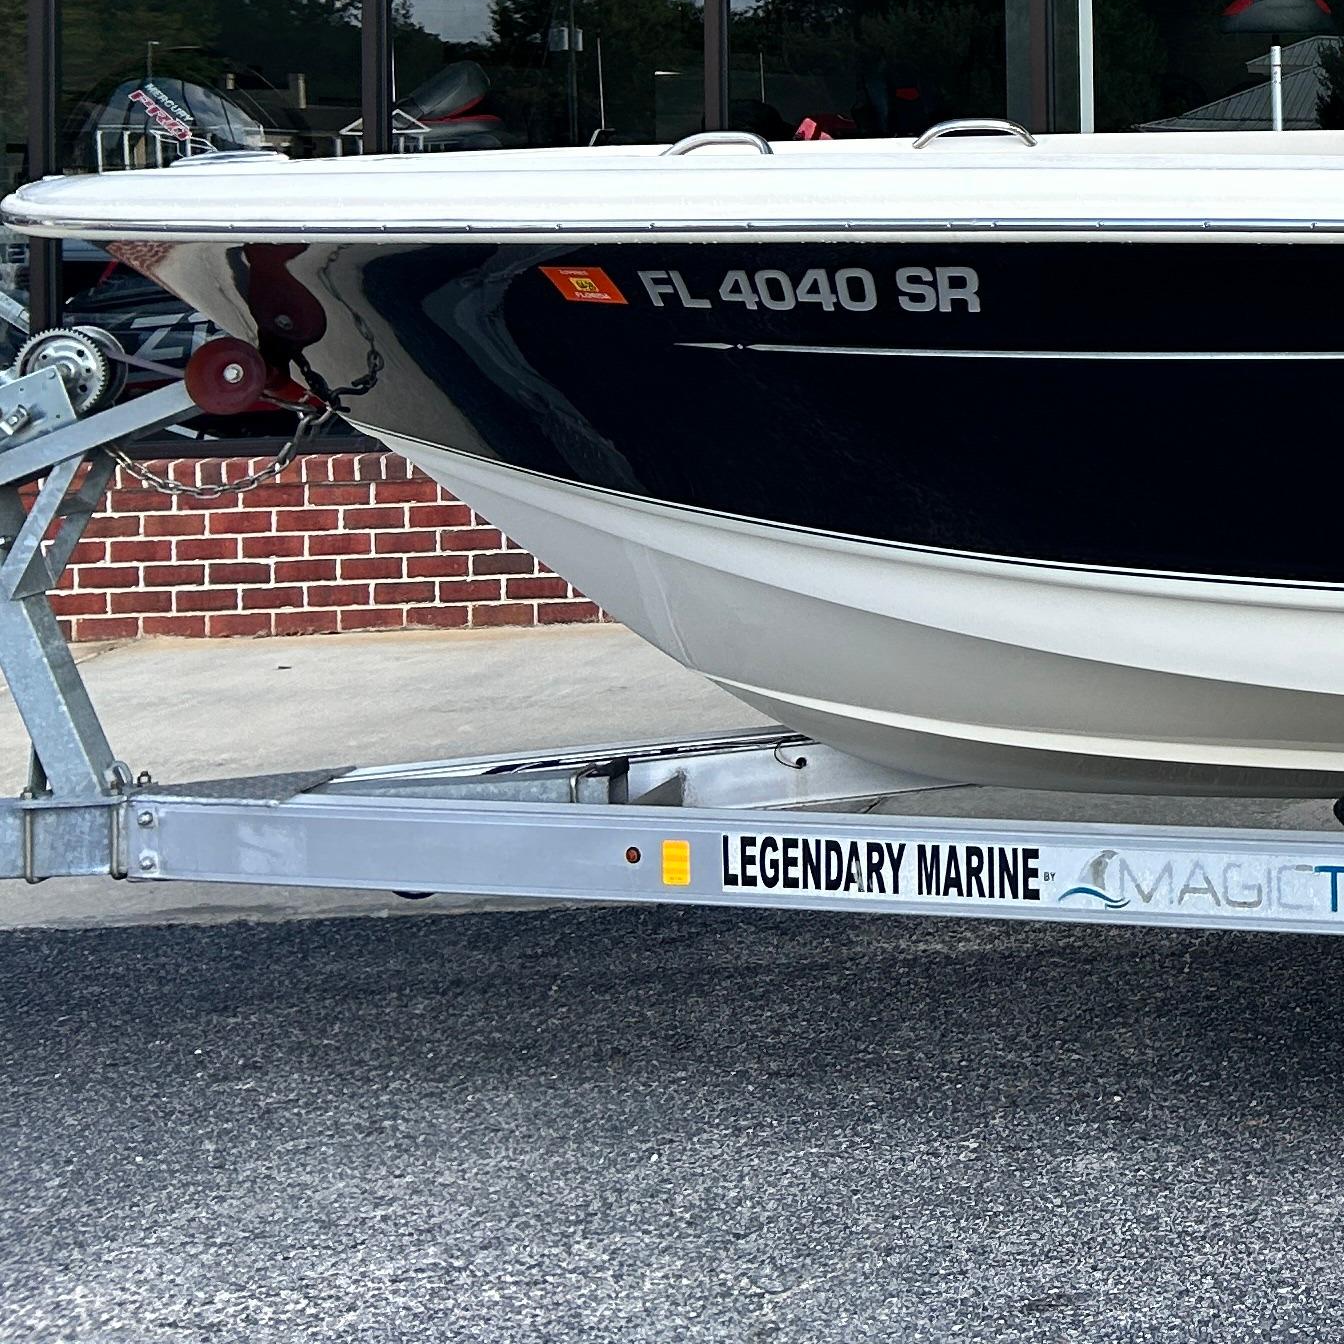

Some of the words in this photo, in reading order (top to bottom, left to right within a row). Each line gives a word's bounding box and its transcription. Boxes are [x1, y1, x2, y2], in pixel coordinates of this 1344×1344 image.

[144, 82, 195, 122] MERCURY
[637, 269, 712, 309] FL
[718, 268, 876, 311] 4040
[895, 266, 981, 313] SR
[721, 835, 907, 894] LEGENDARY
[917, 844, 1041, 901] MARINE
[1043, 871, 1056, 882] BY
